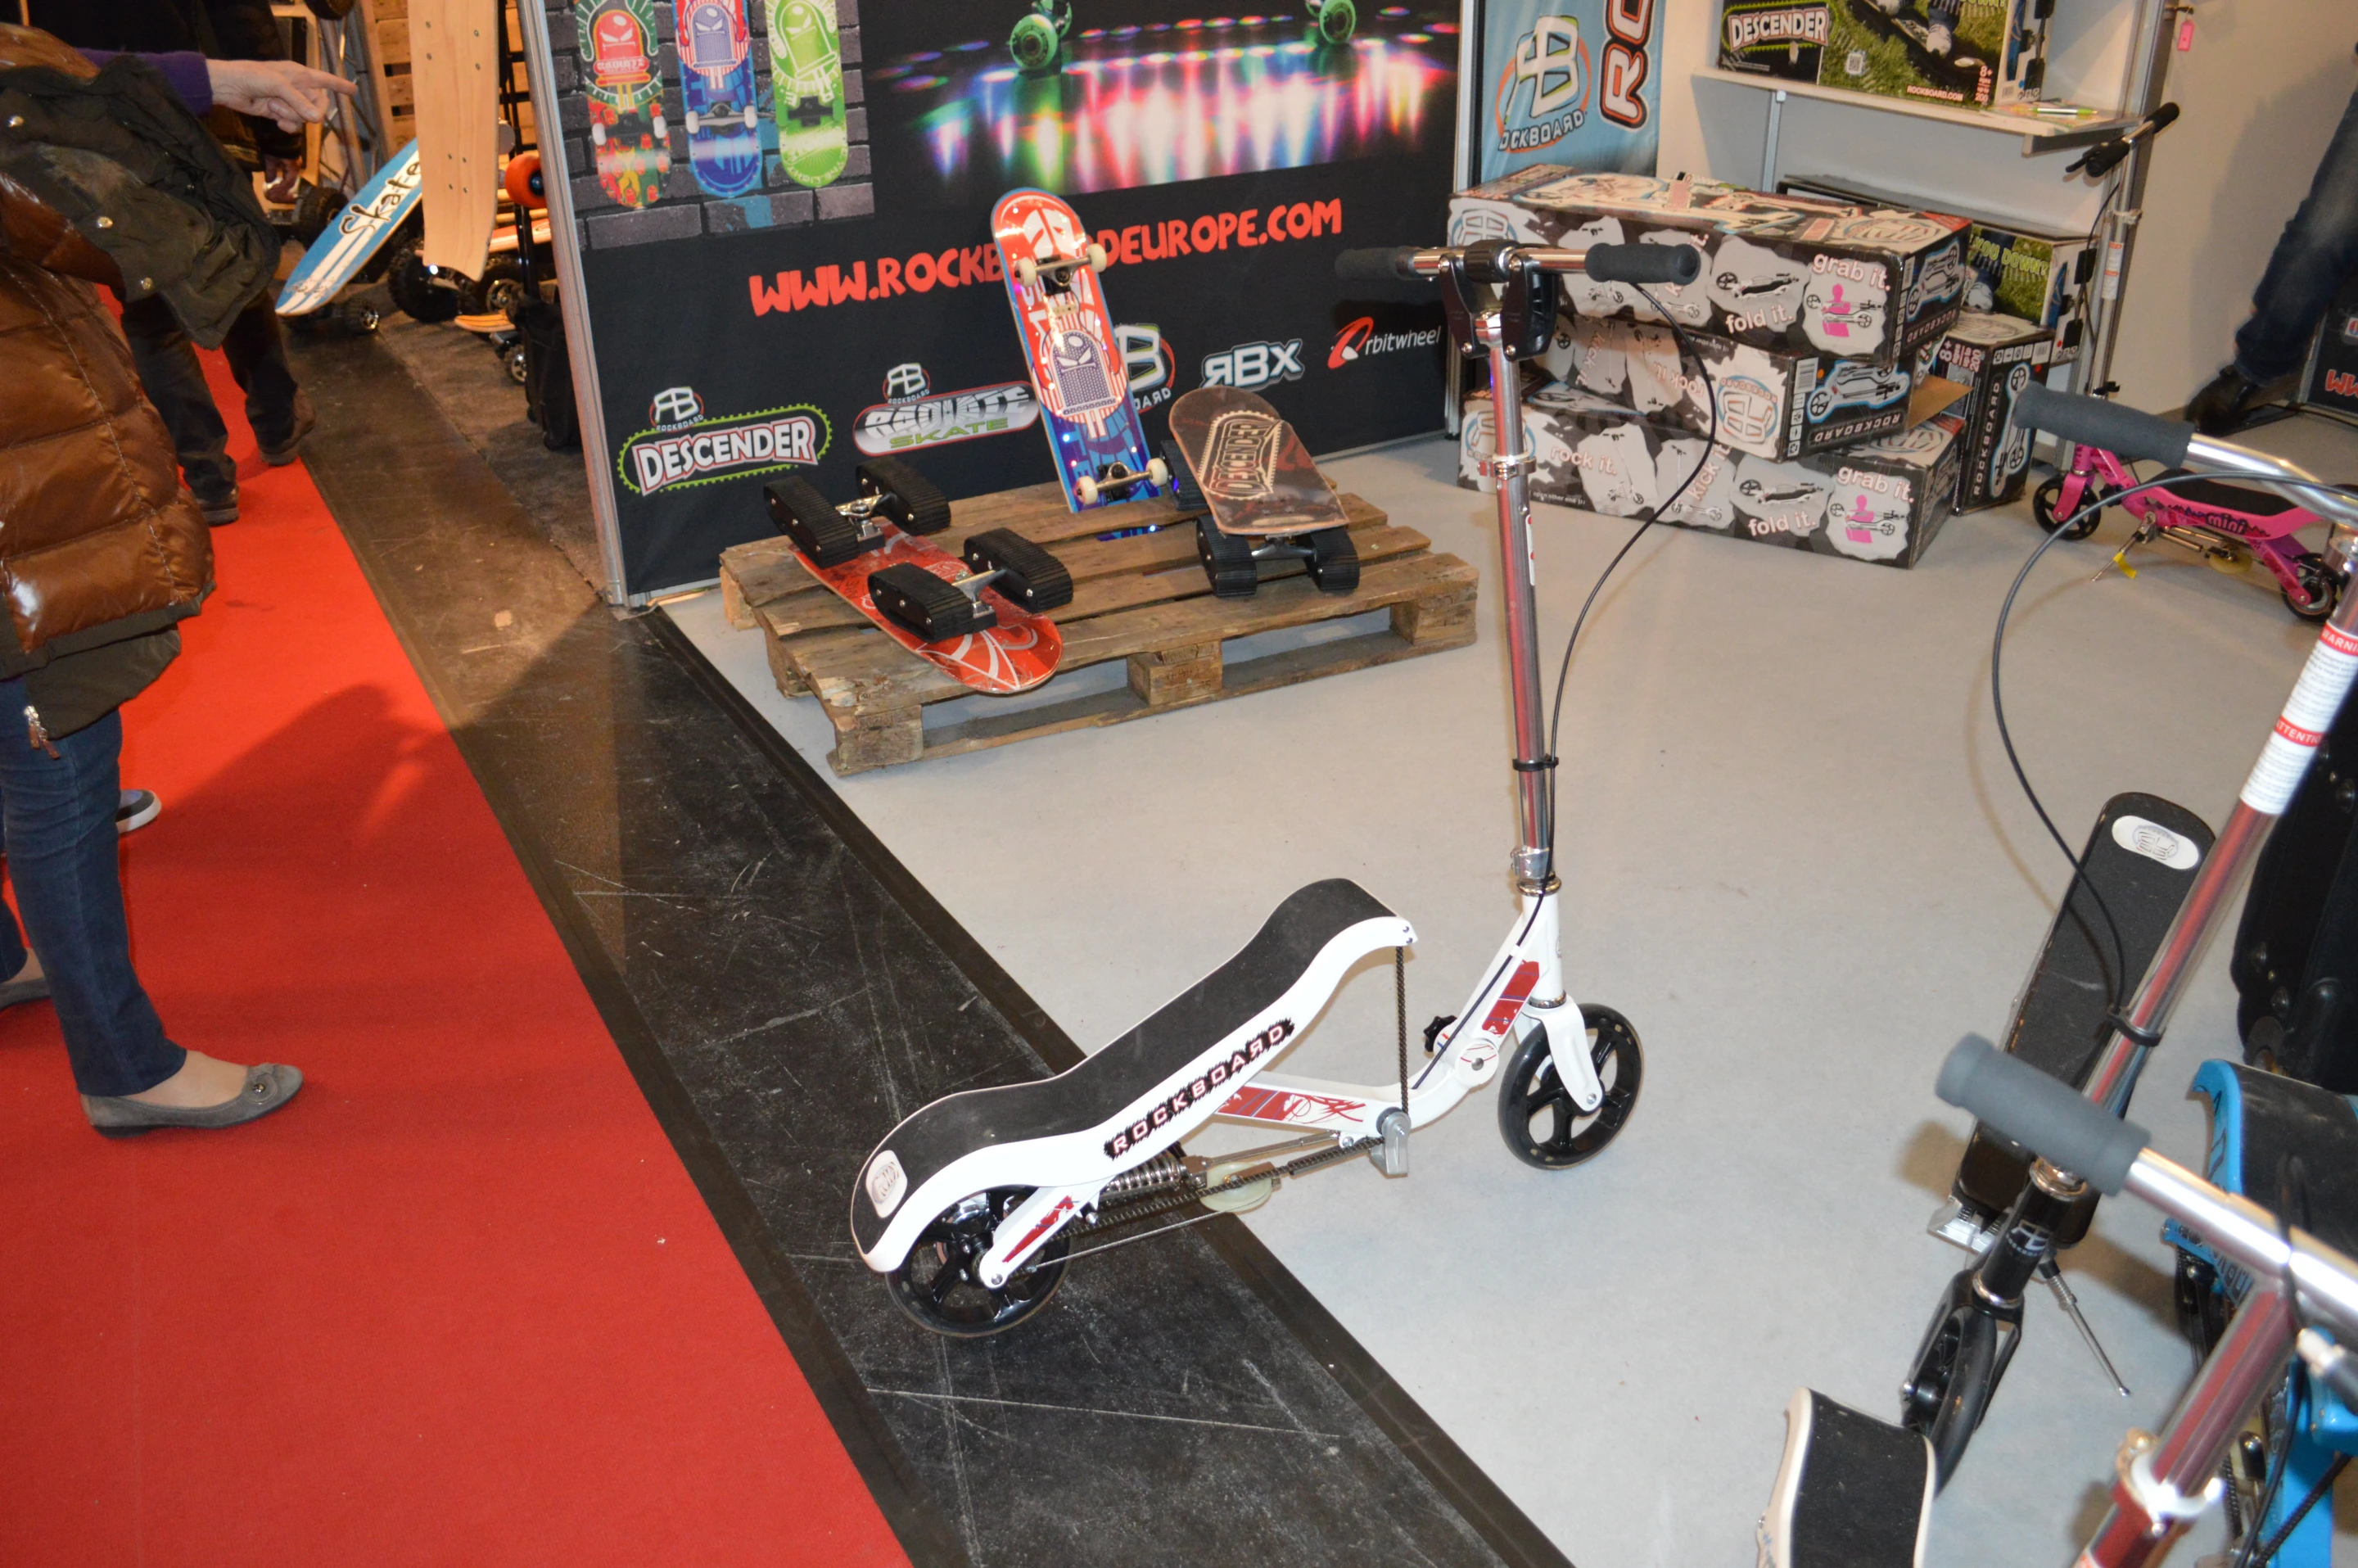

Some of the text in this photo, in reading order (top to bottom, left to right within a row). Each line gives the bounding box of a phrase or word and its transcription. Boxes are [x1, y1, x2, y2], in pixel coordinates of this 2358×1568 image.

[1728, 8, 1828, 51] DESCENDER
[1907, 84, 1963, 102] ROCKBOARD.COM
[1497, 110, 1585, 152] OCKBOARD
[1812, 253, 1891, 291] grab it.
[2001, 247, 2049, 276] DOWN?
[1725, 304, 1794, 334] fold it.
[1939, 340, 1953, 362] 8+
[1970, 349, 1982, 373] 200
[888, 389, 930, 404] ROCKBOARD
[1670, 373, 1705, 398] rock
[1720, 377, 1778, 404] ROCKBOARD
[656, 414, 704, 432] ROCKBOARD
[890, 417, 1009, 450] SKATE
[1814, 413, 1901, 443] ROCKBOARD
[1972, 381, 2001, 496] ROCKBOARD
[635, 418, 817, 493] DESCENDER
[1551, 445, 1618, 477] rock it.
[1687, 462, 1720, 501] kick
[1836, 466, 1915, 504] grab it.
[1547, 492, 1565, 501] other
[1565, 495, 1577, 504] end
[1748, 510, 1817, 537] fold it.
[2207, 513, 2246, 534] mini
[2320, 626, 2358, 654] WARNI
[2276, 719, 2324, 744] ATTENTIO
[1113, 1024, 1284, 1155] ROCKBOARD
